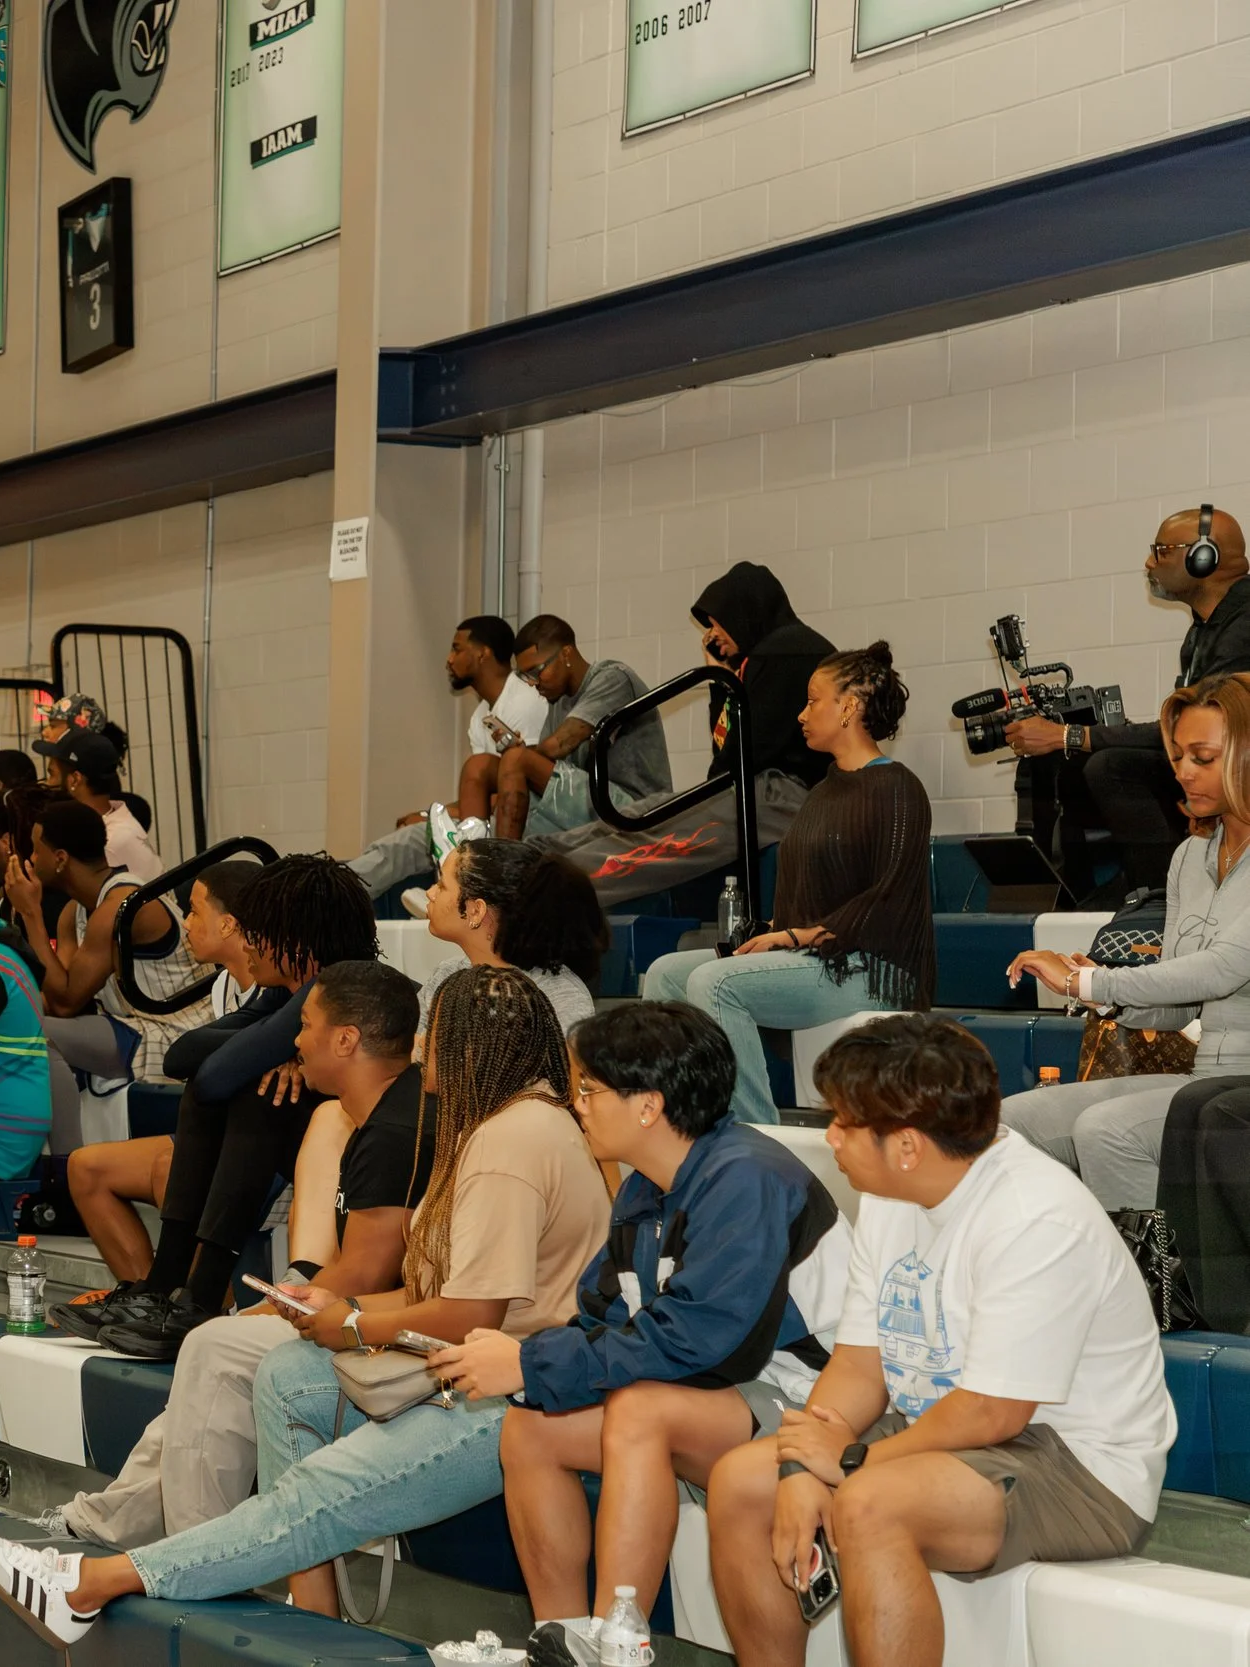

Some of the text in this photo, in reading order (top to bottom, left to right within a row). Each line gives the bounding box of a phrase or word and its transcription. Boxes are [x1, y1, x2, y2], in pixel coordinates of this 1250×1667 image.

[256, 1, 309, 42] MIAA
[635, 0, 712, 45] 2006 2007
[230, 46, 284, 88] 2017 2023
[261, 123, 303, 158] IAAM
[89, 283, 101, 330] 3
